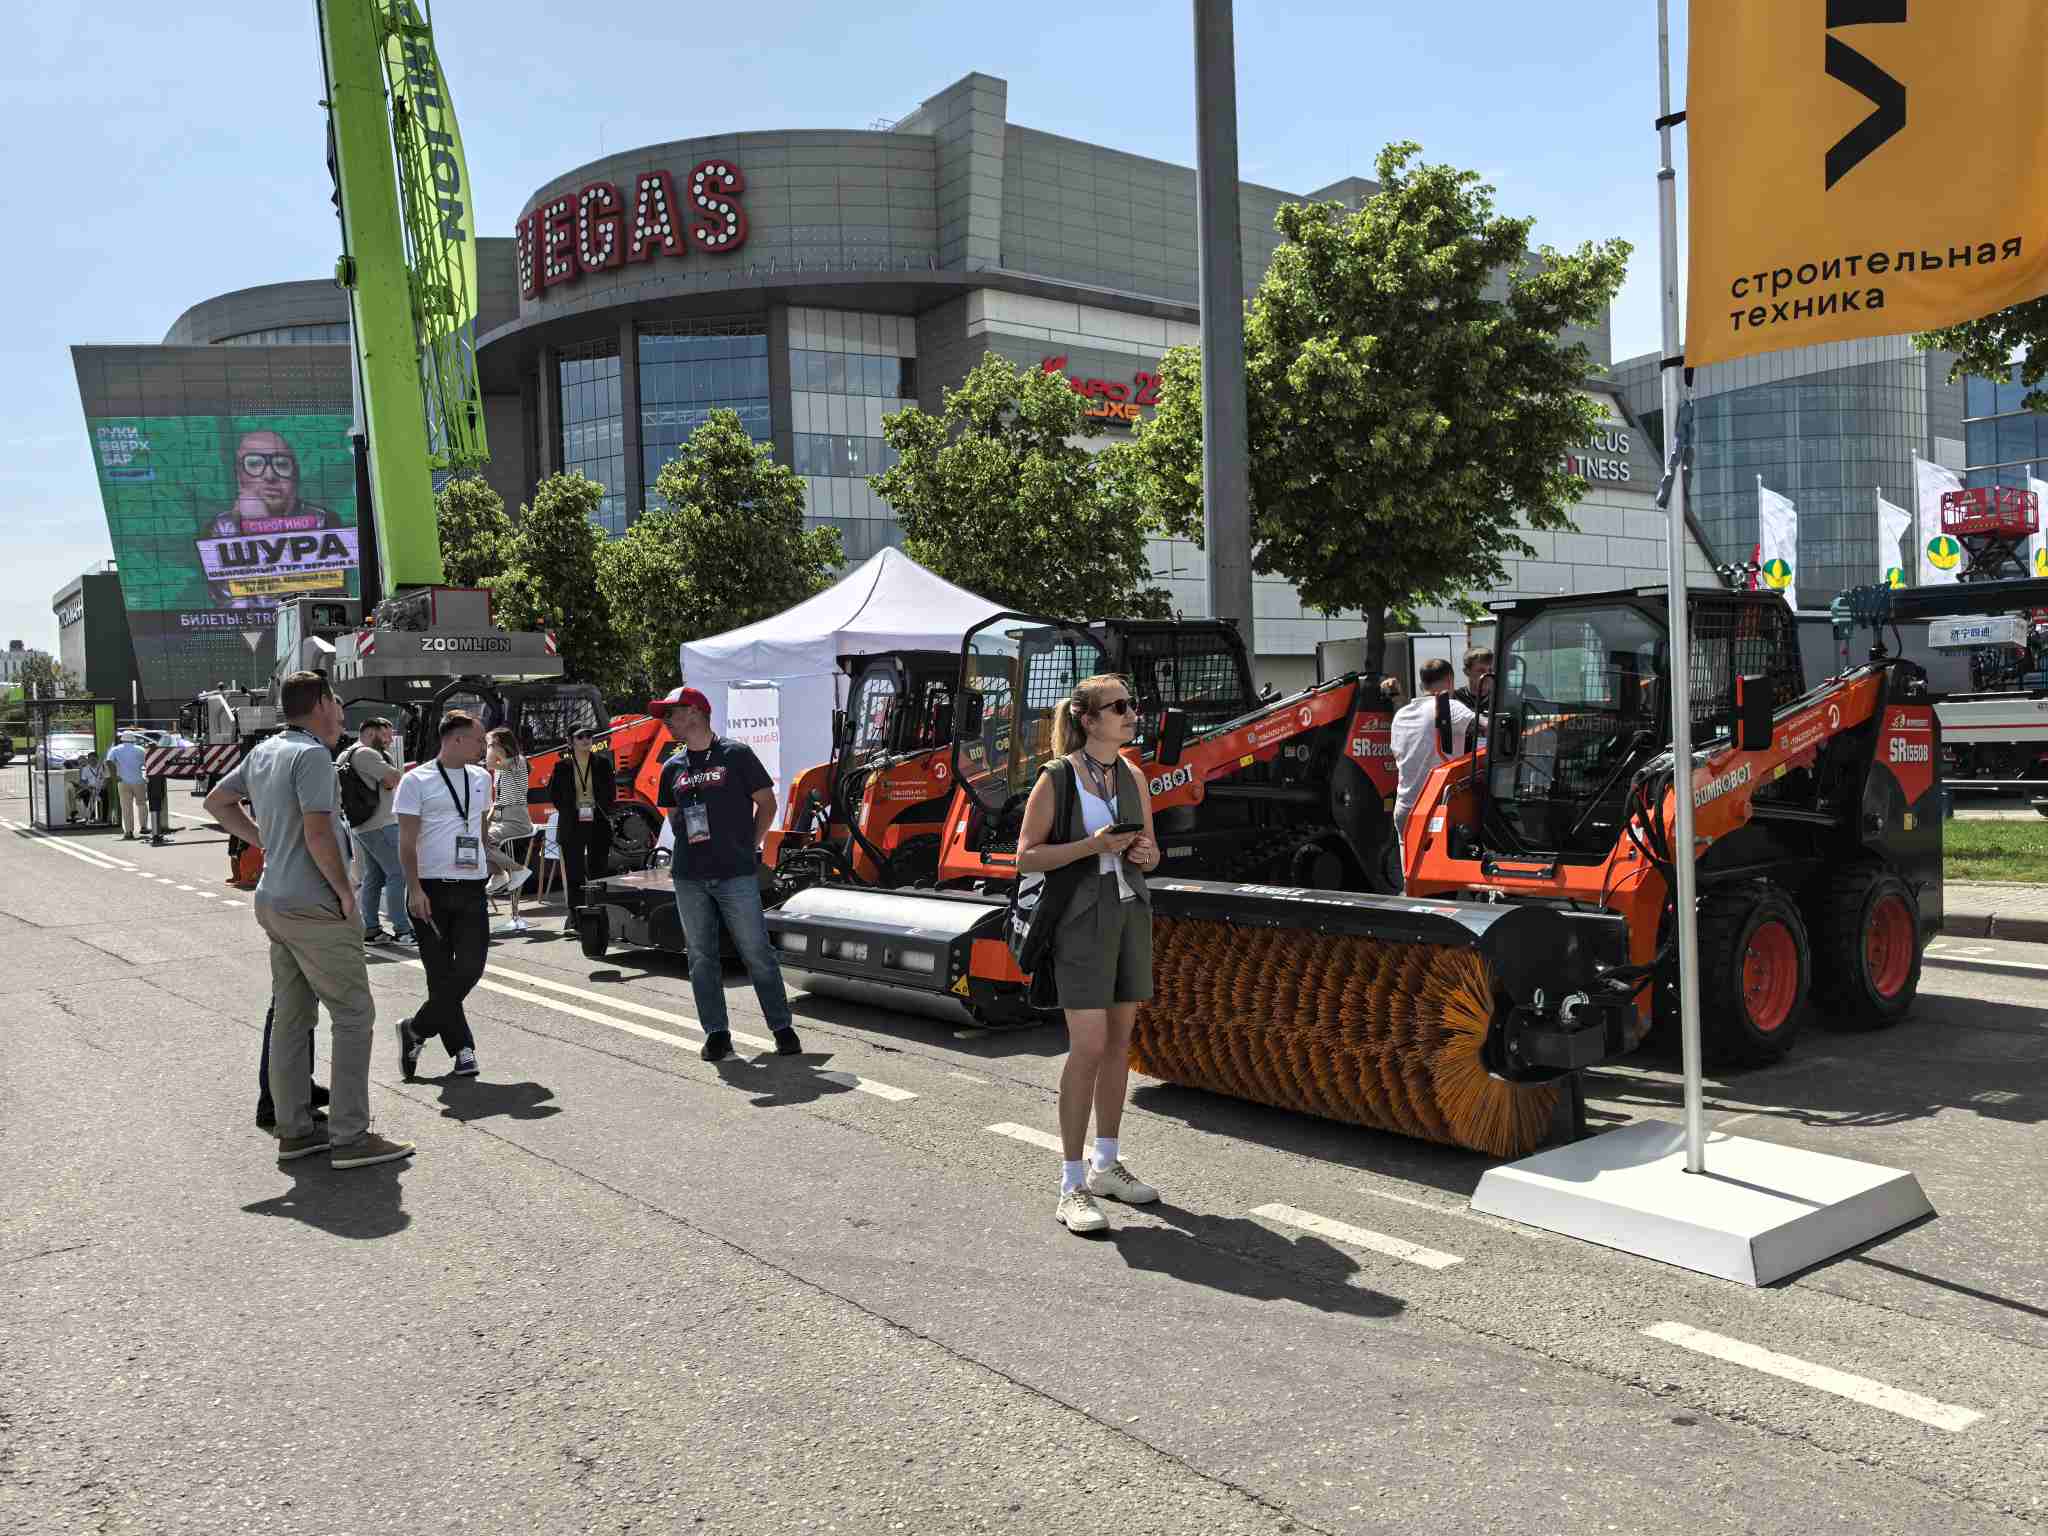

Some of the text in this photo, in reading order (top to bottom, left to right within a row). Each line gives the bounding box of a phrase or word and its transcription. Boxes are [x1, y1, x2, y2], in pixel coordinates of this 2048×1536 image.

[515, 159, 749, 300] VEGAS
[1731, 236, 2023, 299] строительная
[1730, 287, 1885, 331] техника
[217, 533, 350, 567] ШУРА
[181, 612, 244, 626] БИЛЕТЫ:
[421, 637, 512, 652] ZOOMLION
